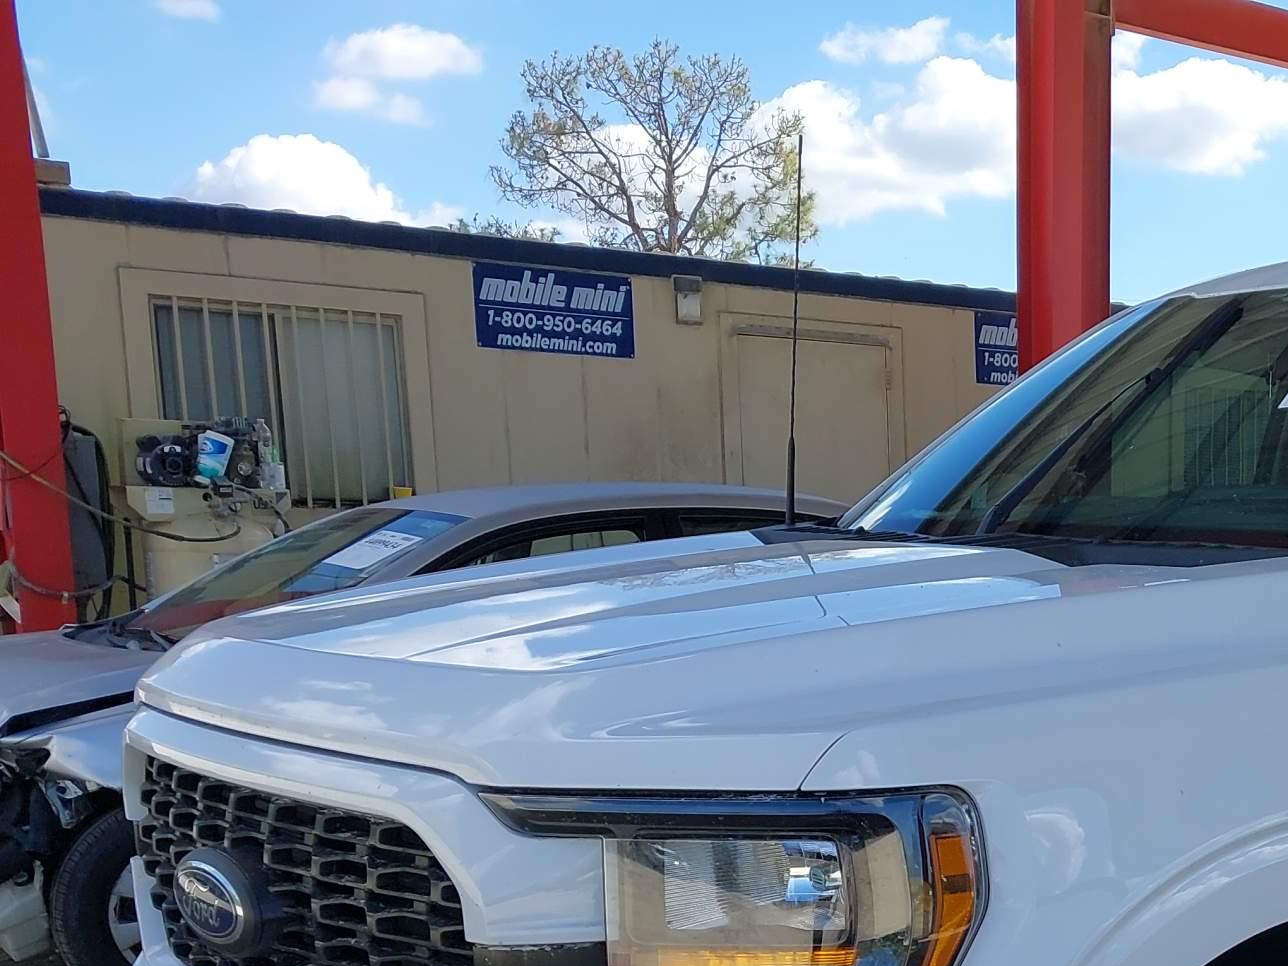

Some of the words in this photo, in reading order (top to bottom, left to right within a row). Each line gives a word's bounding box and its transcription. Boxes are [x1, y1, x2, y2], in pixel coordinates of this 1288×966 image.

[479, 270, 567, 308] mobile
[570, 283, 626, 313] mini
[487, 310, 623, 337] 1-800-950-6464
[496, 332, 617, 355] mobilemini.com
[182, 878, 221, 928] Ford
